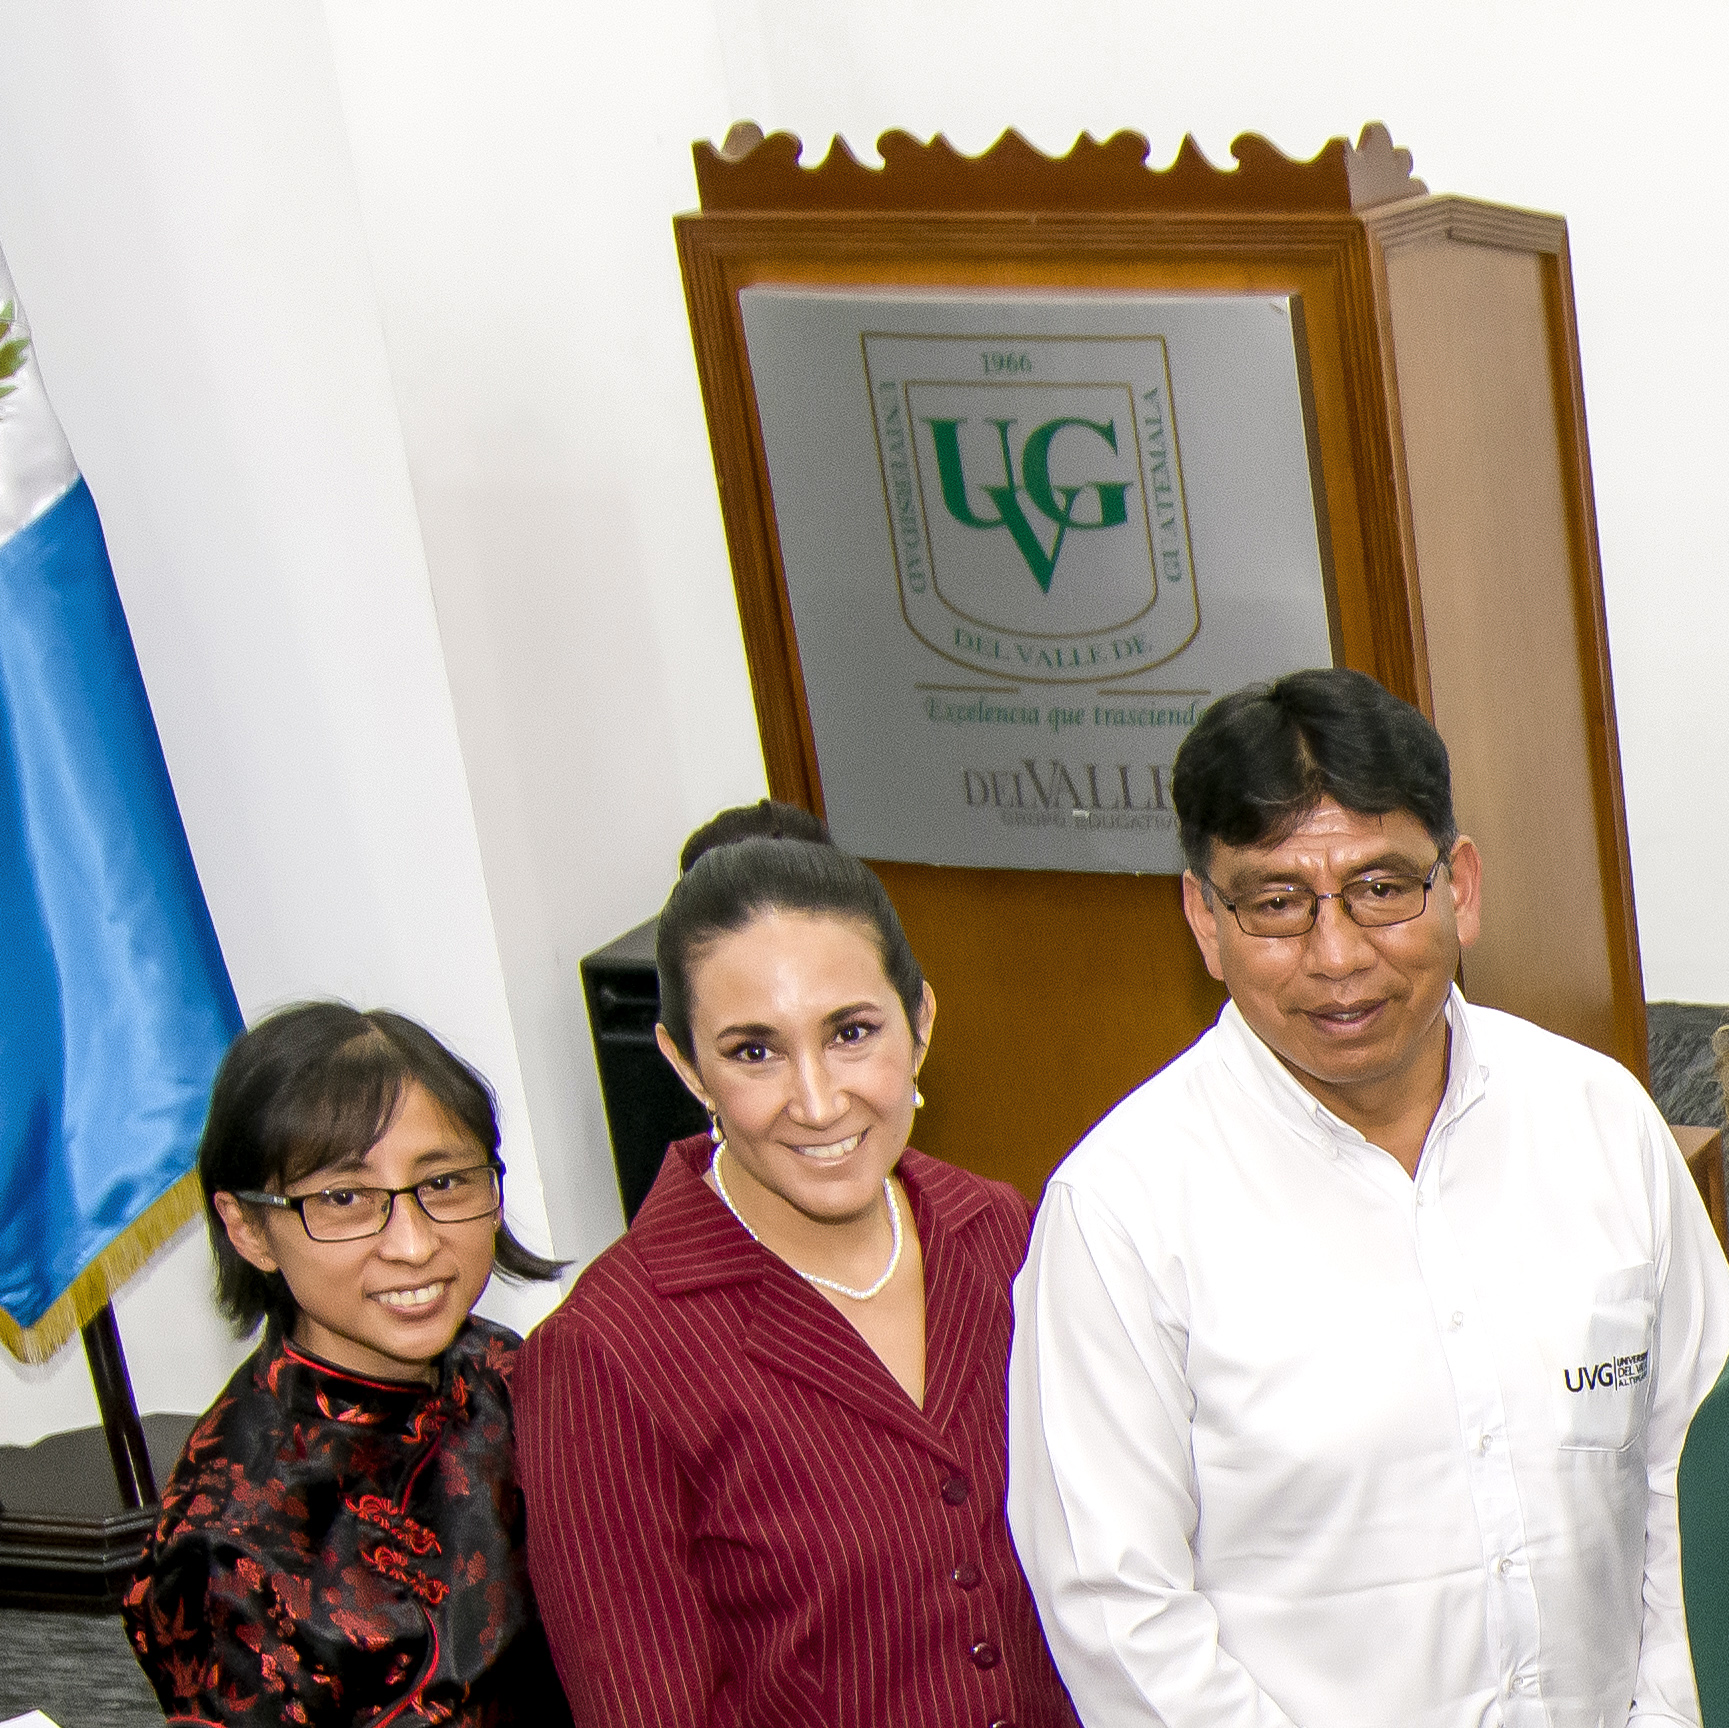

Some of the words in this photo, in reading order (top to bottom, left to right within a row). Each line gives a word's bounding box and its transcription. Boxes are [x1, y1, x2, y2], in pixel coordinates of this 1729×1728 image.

[980, 351, 1033, 375] 1966
[879, 380, 927, 595] UNIVERSIDAD
[1144, 387, 1182, 582] GUATEMALA
[954, 627, 1010, 660] DEL
[1014, 642, 1108, 668] VALLE
[1112, 633, 1152, 660] DE
[924, 695, 1040, 727] Excelencia
[1047, 705, 1086, 733] que
[1564, 1362, 1614, 1392] UVG
